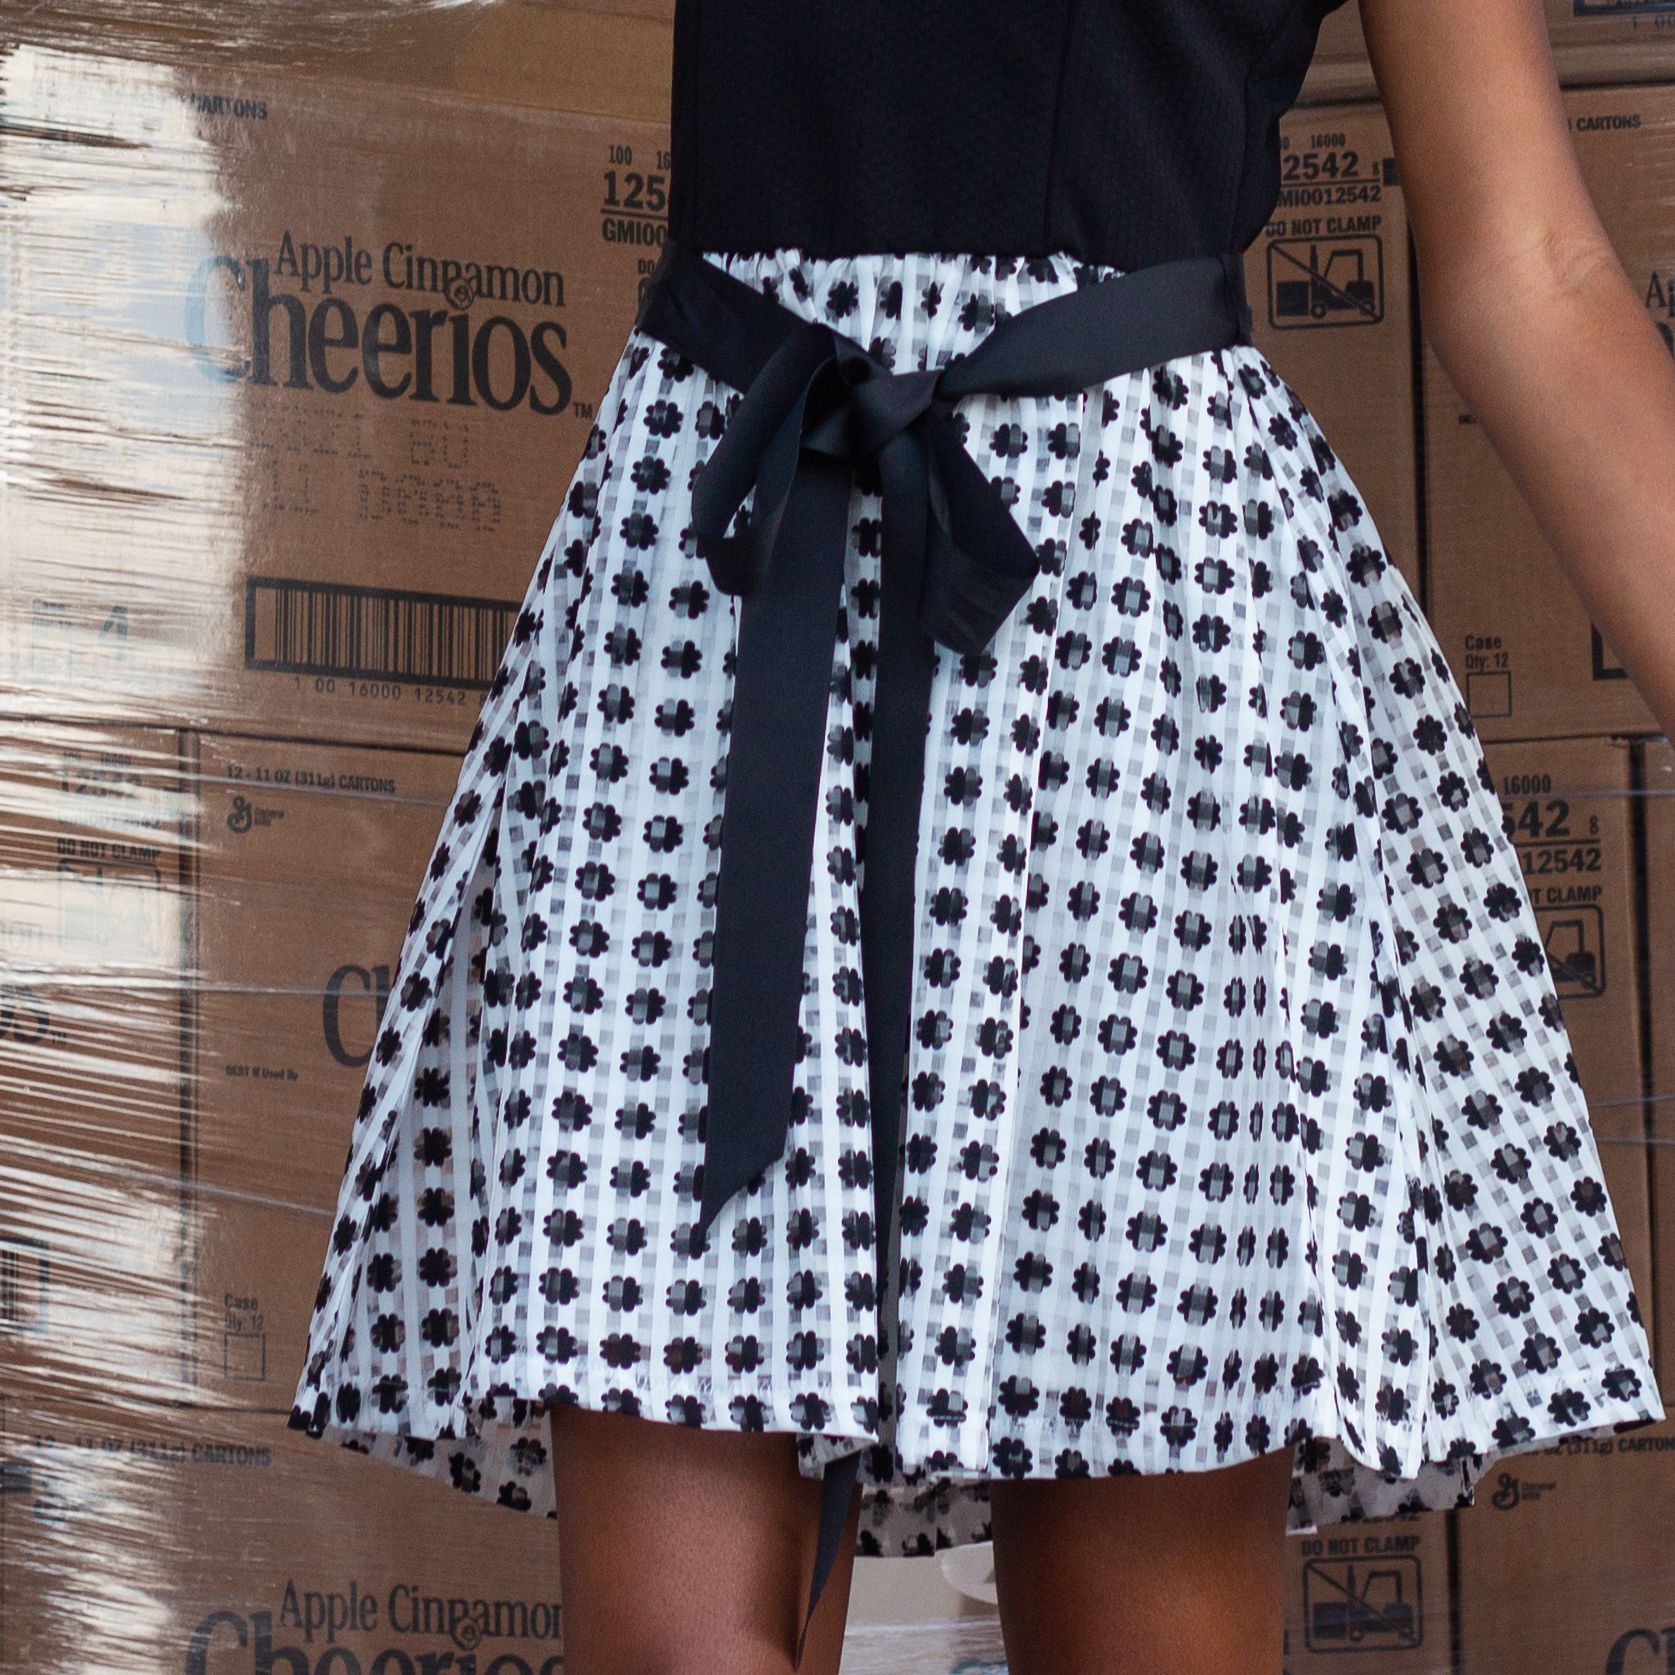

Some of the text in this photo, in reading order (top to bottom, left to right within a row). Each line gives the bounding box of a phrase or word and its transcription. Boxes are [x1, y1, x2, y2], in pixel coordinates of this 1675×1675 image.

[1576, 115, 1641, 132] CARTONS
[1310, 134, 1346, 149] 16000
[608, 144, 633, 166] 100
[1283, 152, 1359, 180] 2542
[1279, 185, 1380, 206] MI0012542
[273, 229, 566, 310] Apple Cinnamon
[185, 254, 572, 416] Cheerios
[1465, 633, 1503, 652] Case
[227, 765, 244, 782] 12
[256, 766, 271, 783] 11
[274, 768, 292, 785] OZ
[339, 774, 396, 794] CARTONS
[1503, 775, 1551, 794] 16000
[1546, 886, 1602, 904] CLAMP
[1564, 1437, 1614, 1458] (311g)
[1300, 1534, 1422, 1556] DO NOT CLAMP
[279, 1580, 378, 1643] Apple
